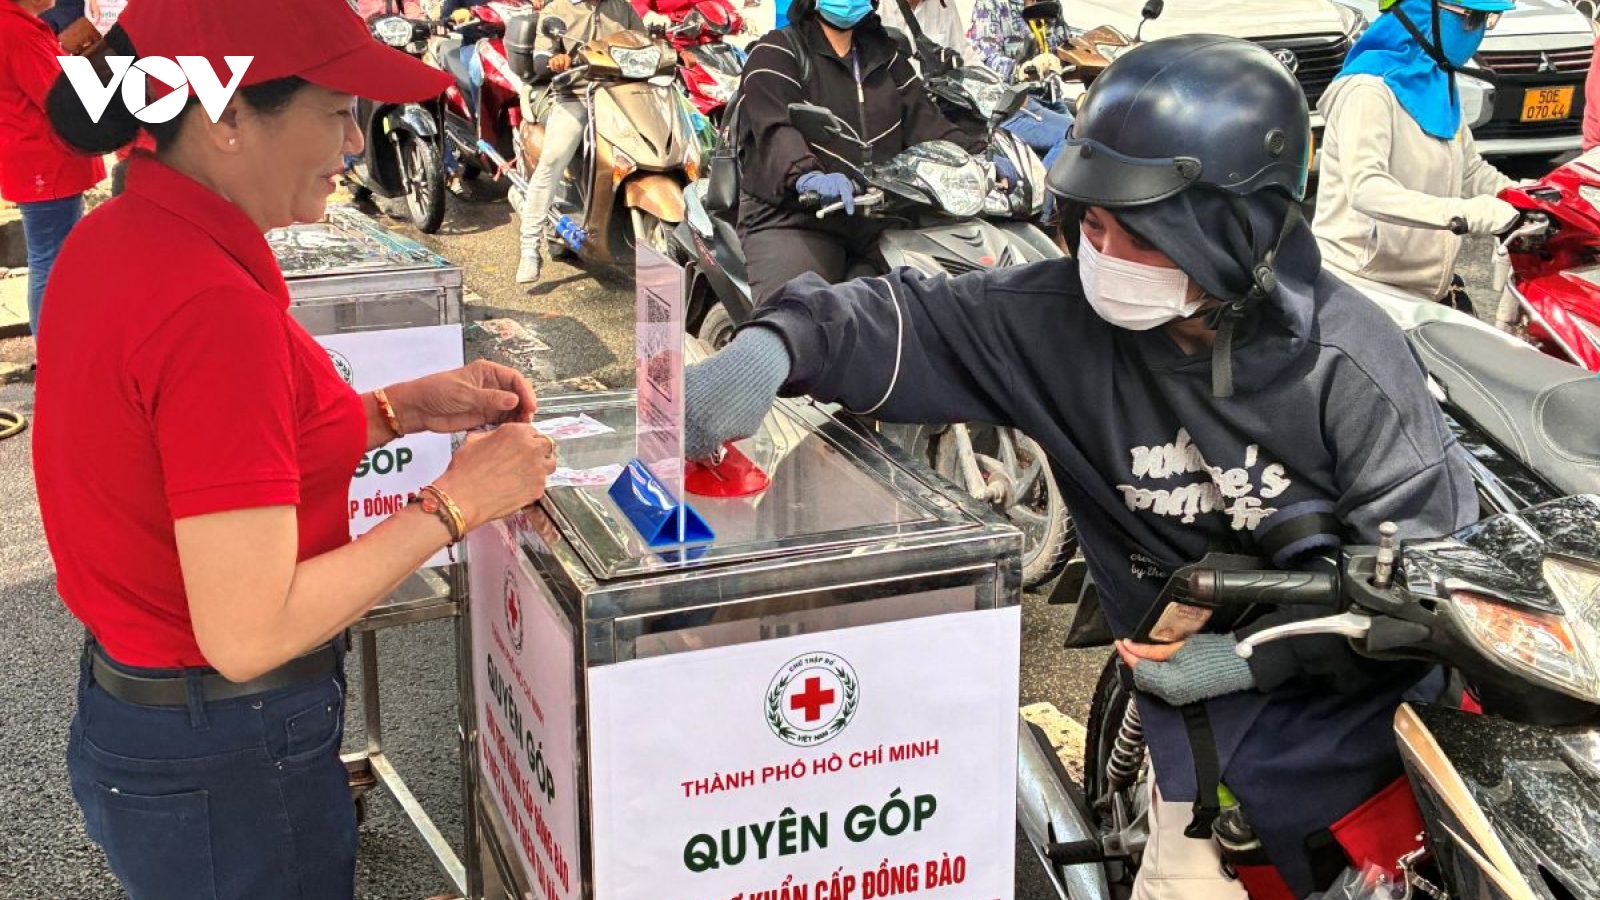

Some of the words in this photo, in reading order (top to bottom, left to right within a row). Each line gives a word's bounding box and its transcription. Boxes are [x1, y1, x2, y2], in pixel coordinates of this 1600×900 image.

[1527, 104, 1565, 118] 070.44
[1539, 90, 1561, 103] 50E
[486, 653, 524, 750] QUYÊN
[526, 730, 555, 804] GÓP
[681, 770, 754, 797] THÀNH
[762, 758, 806, 783] PHỐ
[813, 752, 843, 775] HỒ
[849, 744, 883, 768] CHÍ
[889, 739, 939, 762] MINH
[683, 806, 828, 873] QUYÊN
[844, 787, 937, 843] GÓP
[815, 866, 856, 900] CẤP
[862, 858, 919, 900] ĐỒNG
[925, 852, 966, 889] BÀO
